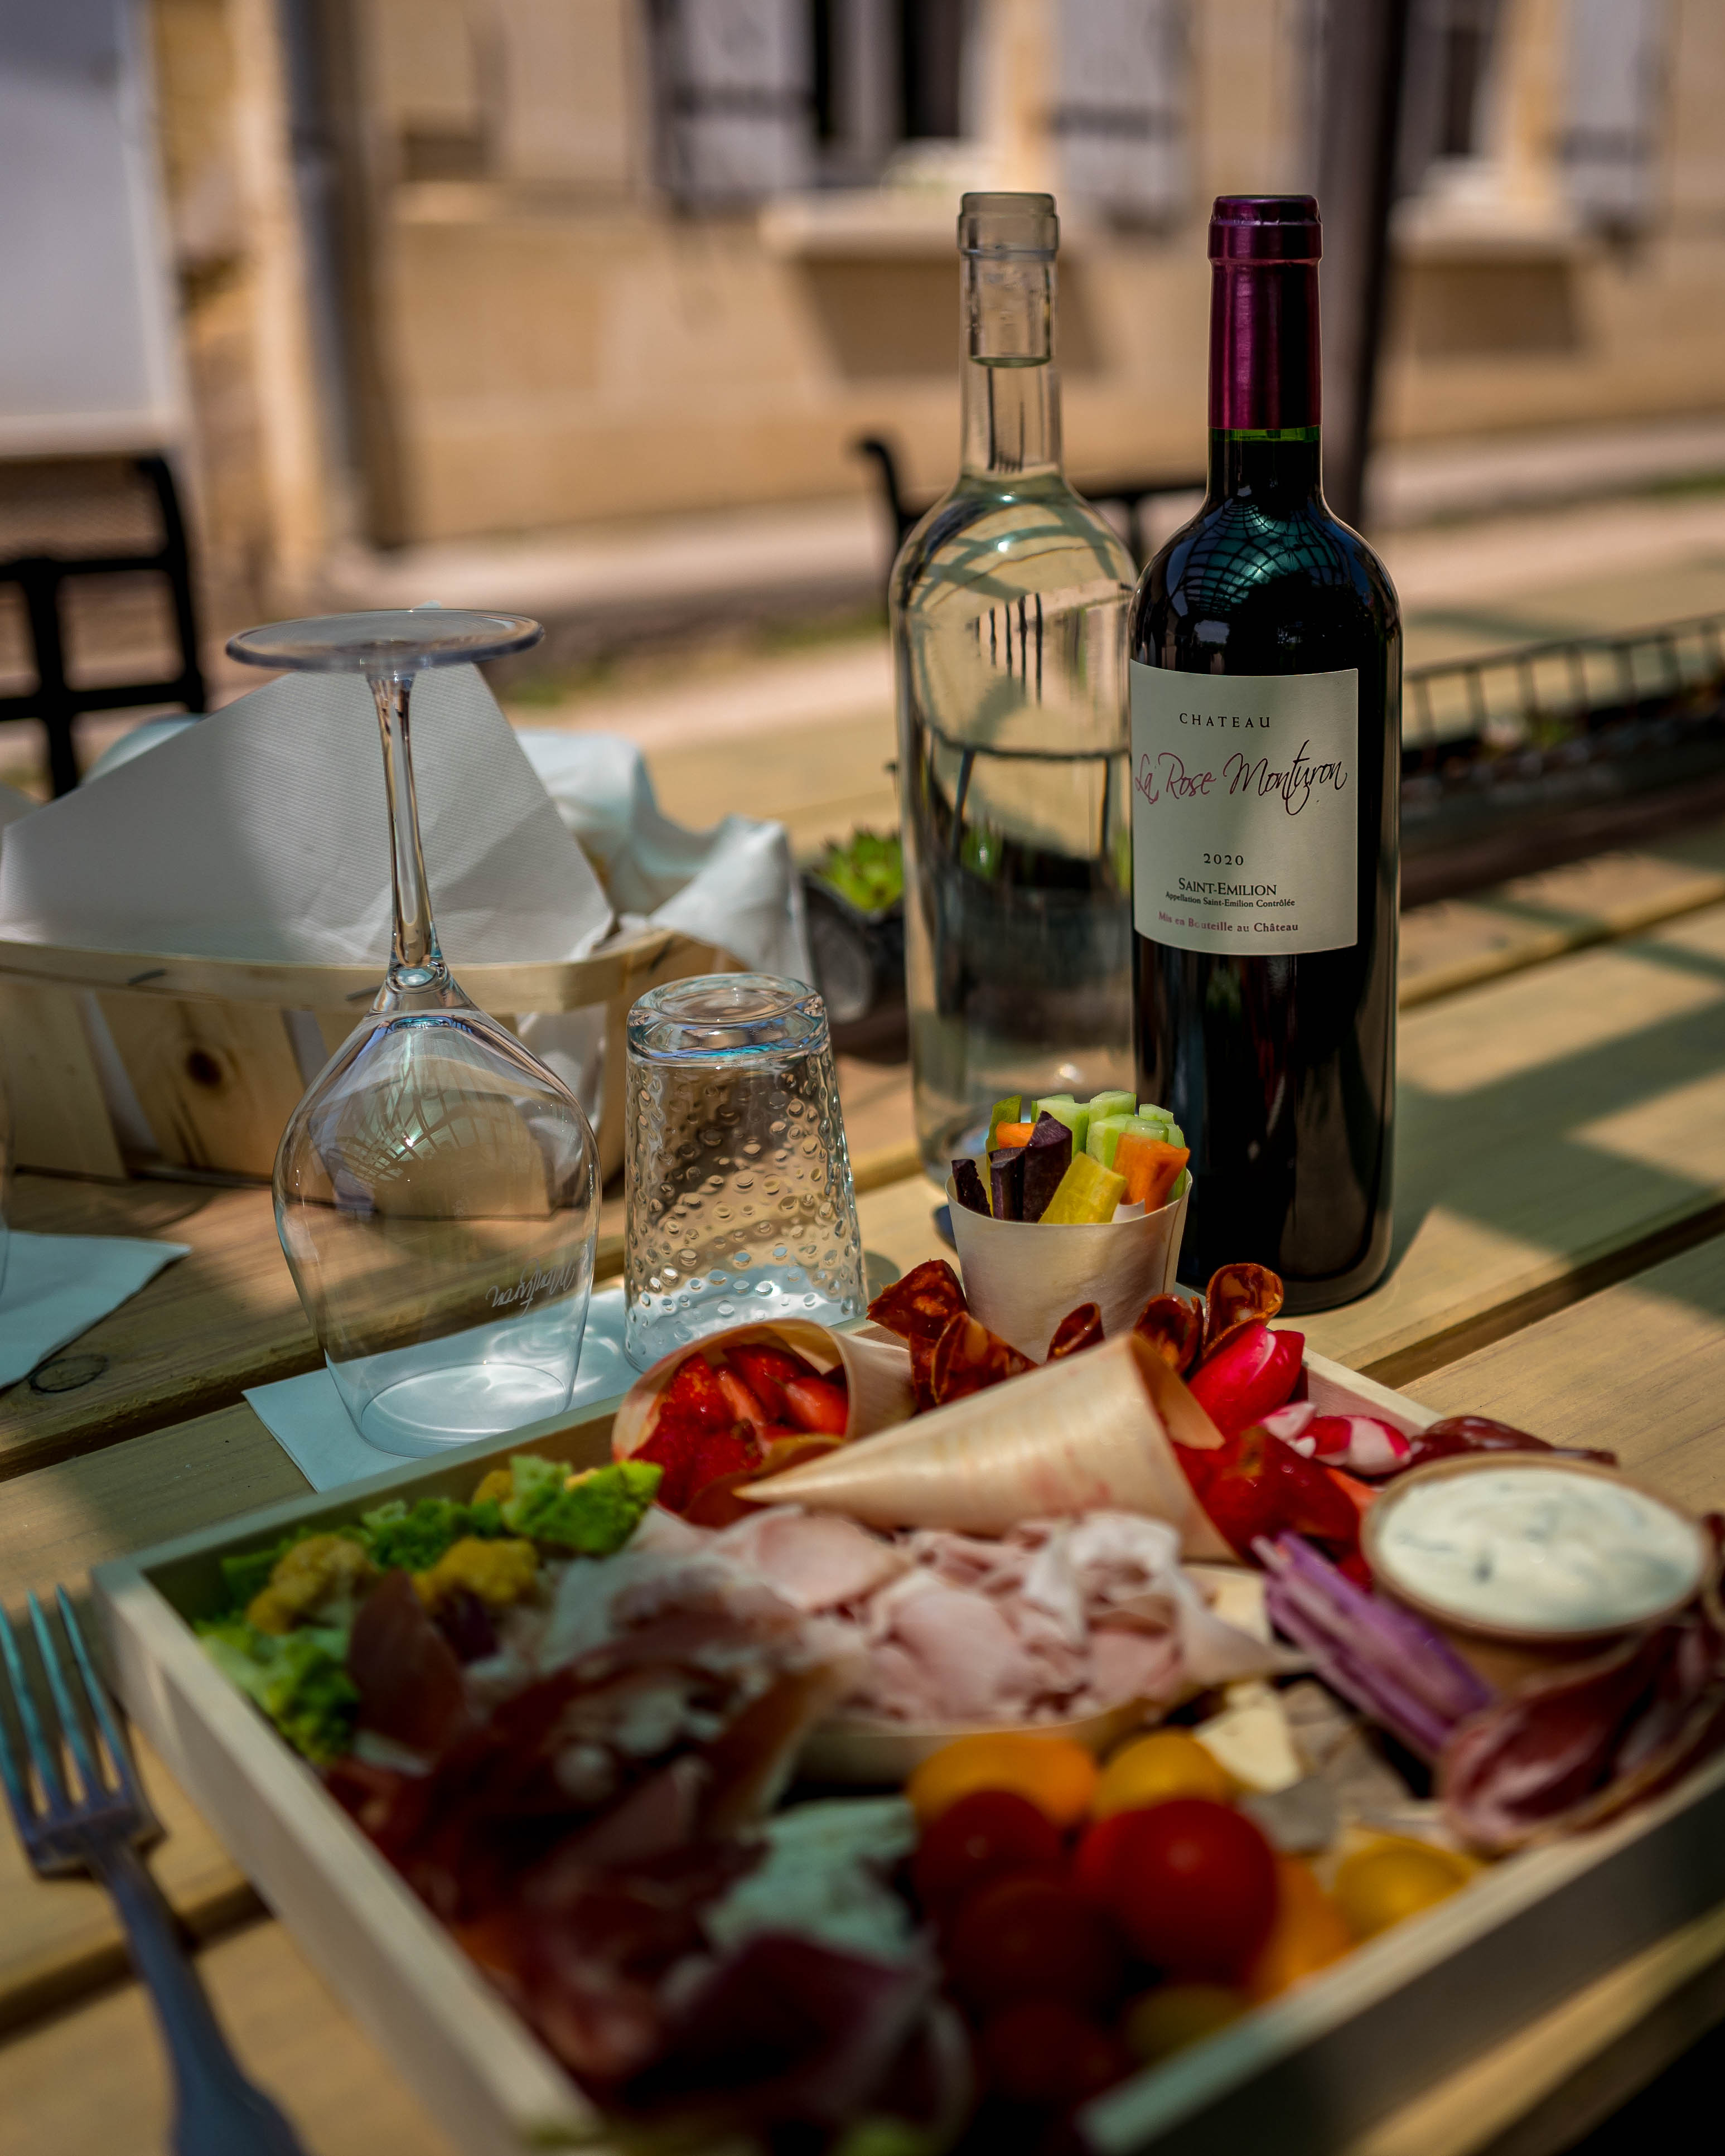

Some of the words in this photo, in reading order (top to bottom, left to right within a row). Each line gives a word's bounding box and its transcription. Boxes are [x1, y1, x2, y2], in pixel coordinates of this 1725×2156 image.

[1179, 713, 1270, 728] CHATEAU
[1135, 754, 1159, 804] La
[1158, 752, 1217, 799] Rose
[1223, 739, 1347, 815] Monturon
[1204, 853, 1244, 866] 2020
[1178, 877, 1277, 896] SAINT-EMILION
[1166, 891, 1201, 905] Appellation
[1203, 897, 1254, 907] Saint-Emilion
[1256, 899, 1296, 907] Contrôlée
[1158, 911, 1172, 923] Mis
[1188, 917, 1233, 932] Bouteille
[1254, 922, 1298, 932] Château
